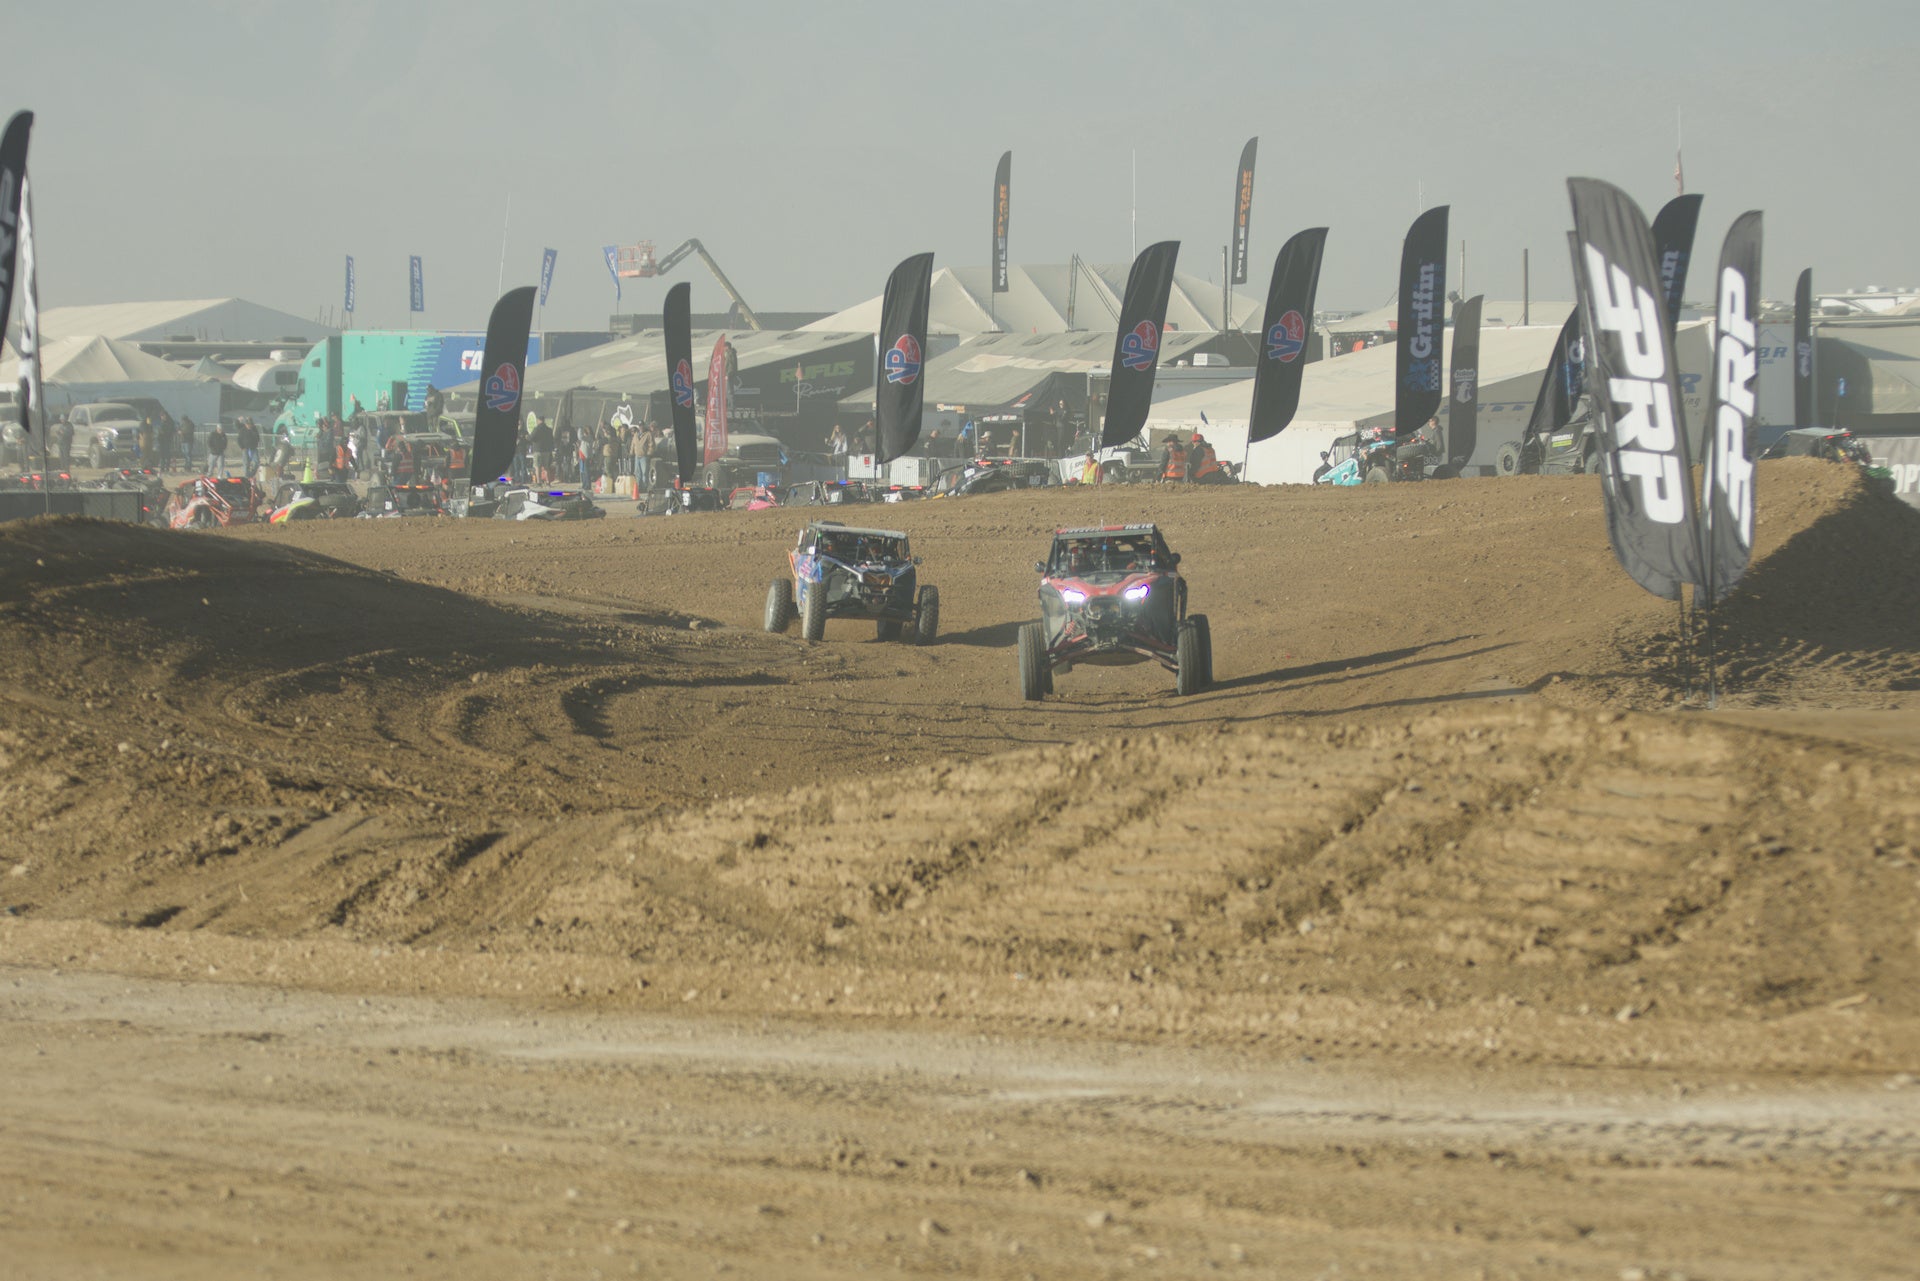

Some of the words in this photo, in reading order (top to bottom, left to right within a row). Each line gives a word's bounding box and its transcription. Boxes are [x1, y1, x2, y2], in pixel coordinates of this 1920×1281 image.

[1410, 262, 1434, 358] Griffin
[1121, 332, 1157, 367] VP
[1267, 323, 1304, 359] VP
[779, 360, 855, 384] RUFUS
[885, 348, 920, 383] VP
[1586, 242, 1685, 524] PRP
[486, 374, 519, 409] VP
[673, 371, 692, 406] VP
[1716, 266, 1756, 549] PRP
